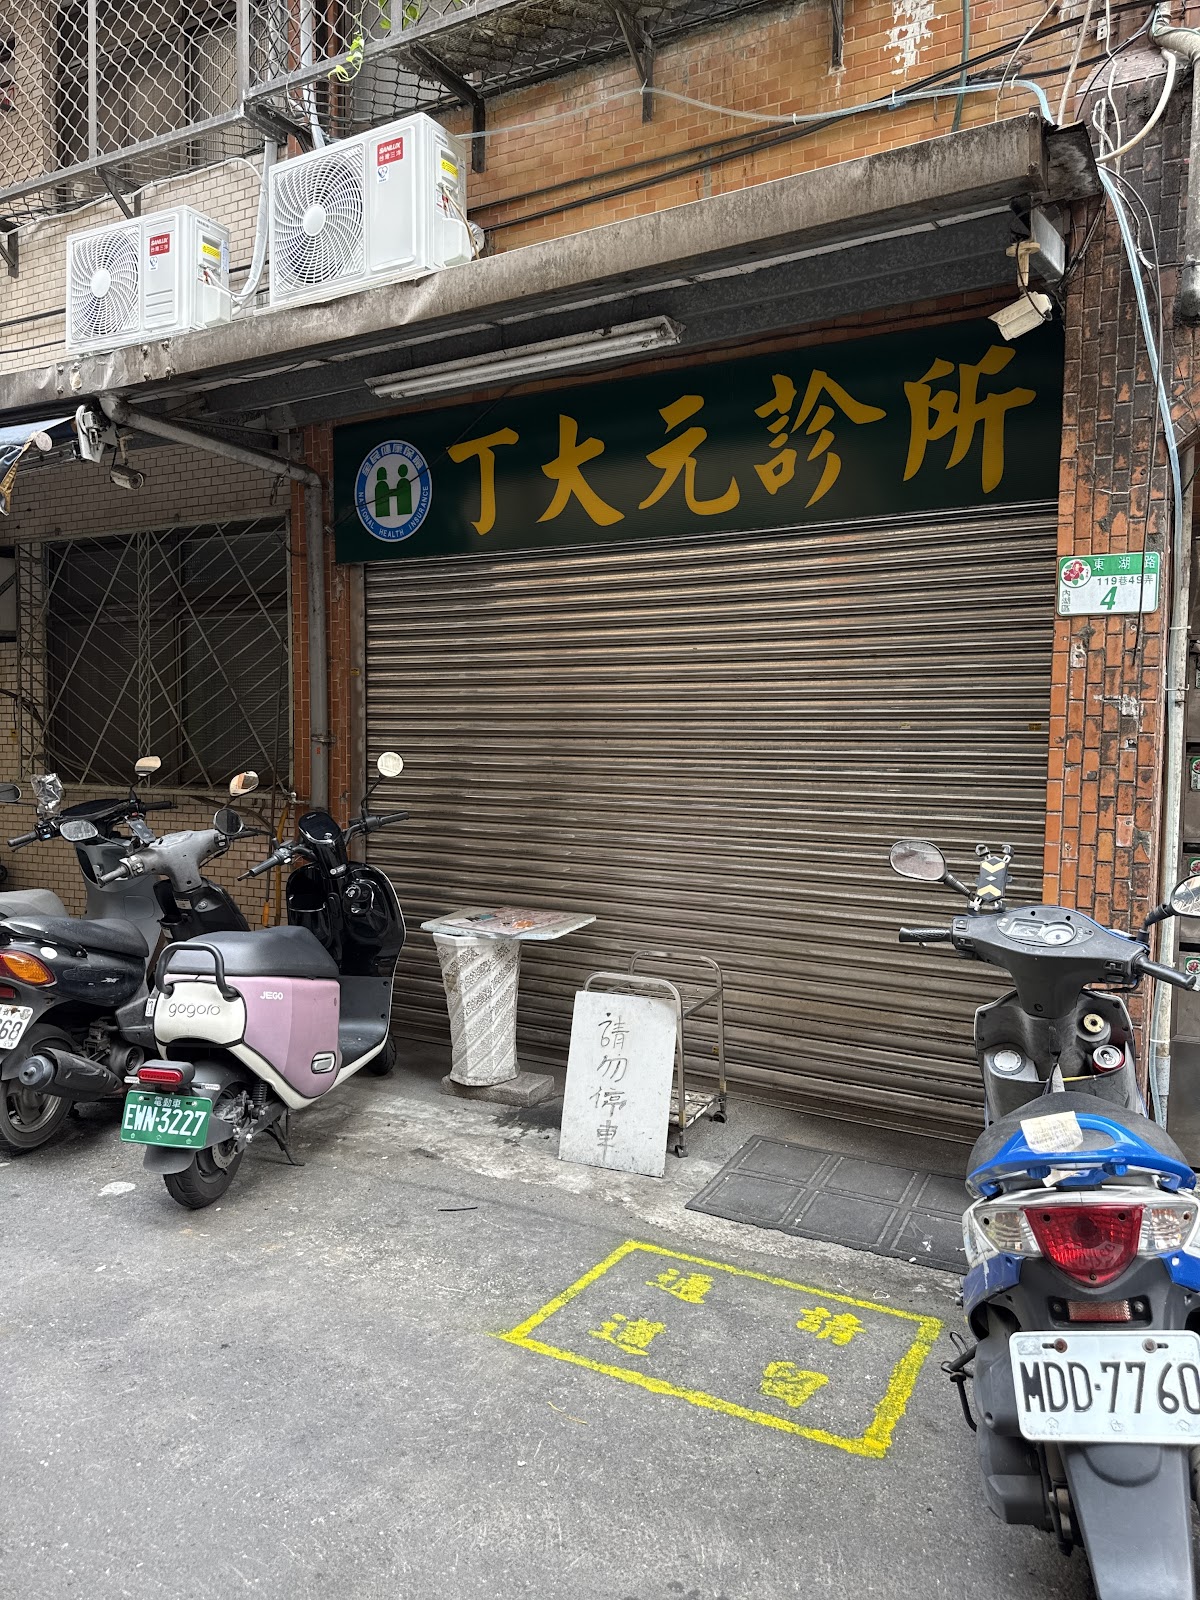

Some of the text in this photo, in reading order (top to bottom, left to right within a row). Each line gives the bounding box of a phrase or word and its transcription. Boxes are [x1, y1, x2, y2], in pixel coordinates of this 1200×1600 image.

[379, 142, 401, 154] SANLUX
[445, 345, 1037, 536] 丁大元診所
[362, 443, 424, 477] 全民健康保險
[378, 528, 405, 538] HEALTH
[408, 485, 429, 531] INSURANCE
[1093, 555, 1156, 572] 東湖路
[1100, 586, 1118, 610] 4
[260, 991, 284, 1000] JEGO
[168, 1003, 221, 1018] gogoro
[589, 1012, 630, 1161] 請勿停車
[154, 1095, 182, 1108] 電動車
